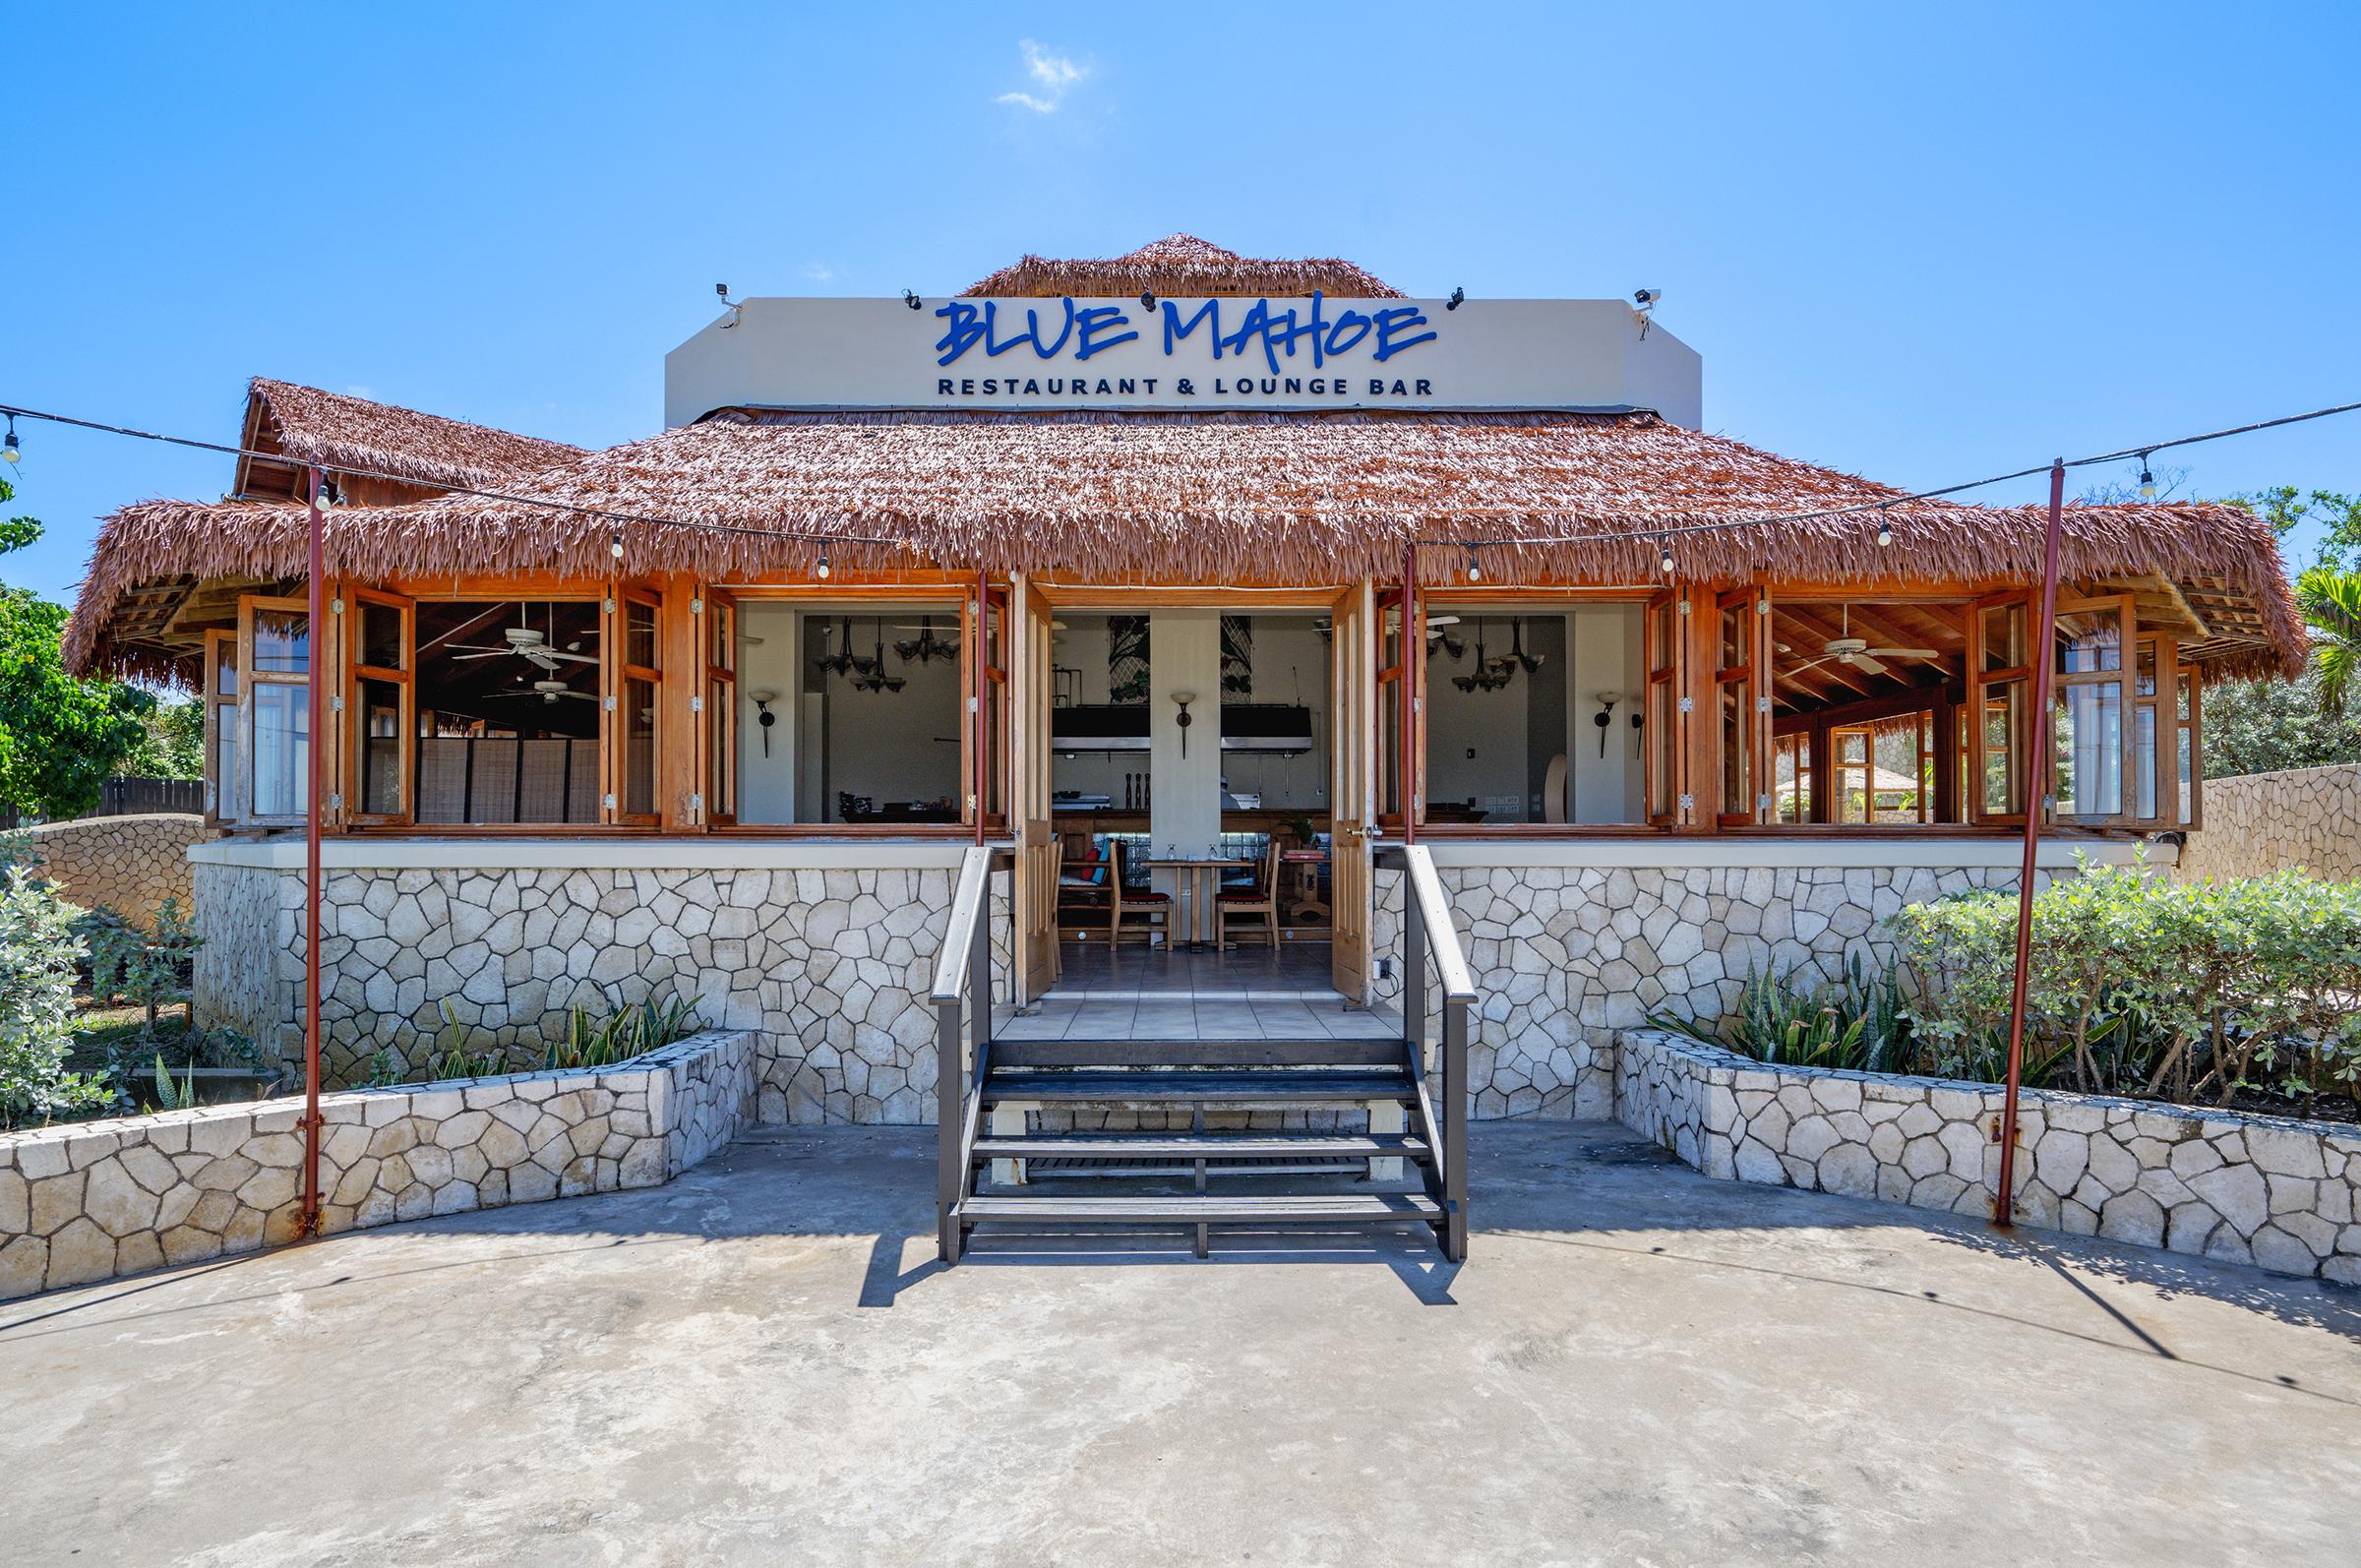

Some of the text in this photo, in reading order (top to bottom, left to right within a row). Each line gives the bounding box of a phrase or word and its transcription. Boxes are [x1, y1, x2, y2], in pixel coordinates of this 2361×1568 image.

[936, 291, 1437, 375] BLUE MAHOE
[938, 379, 1432, 395] RESTAURANT & LOUNGE BAR
